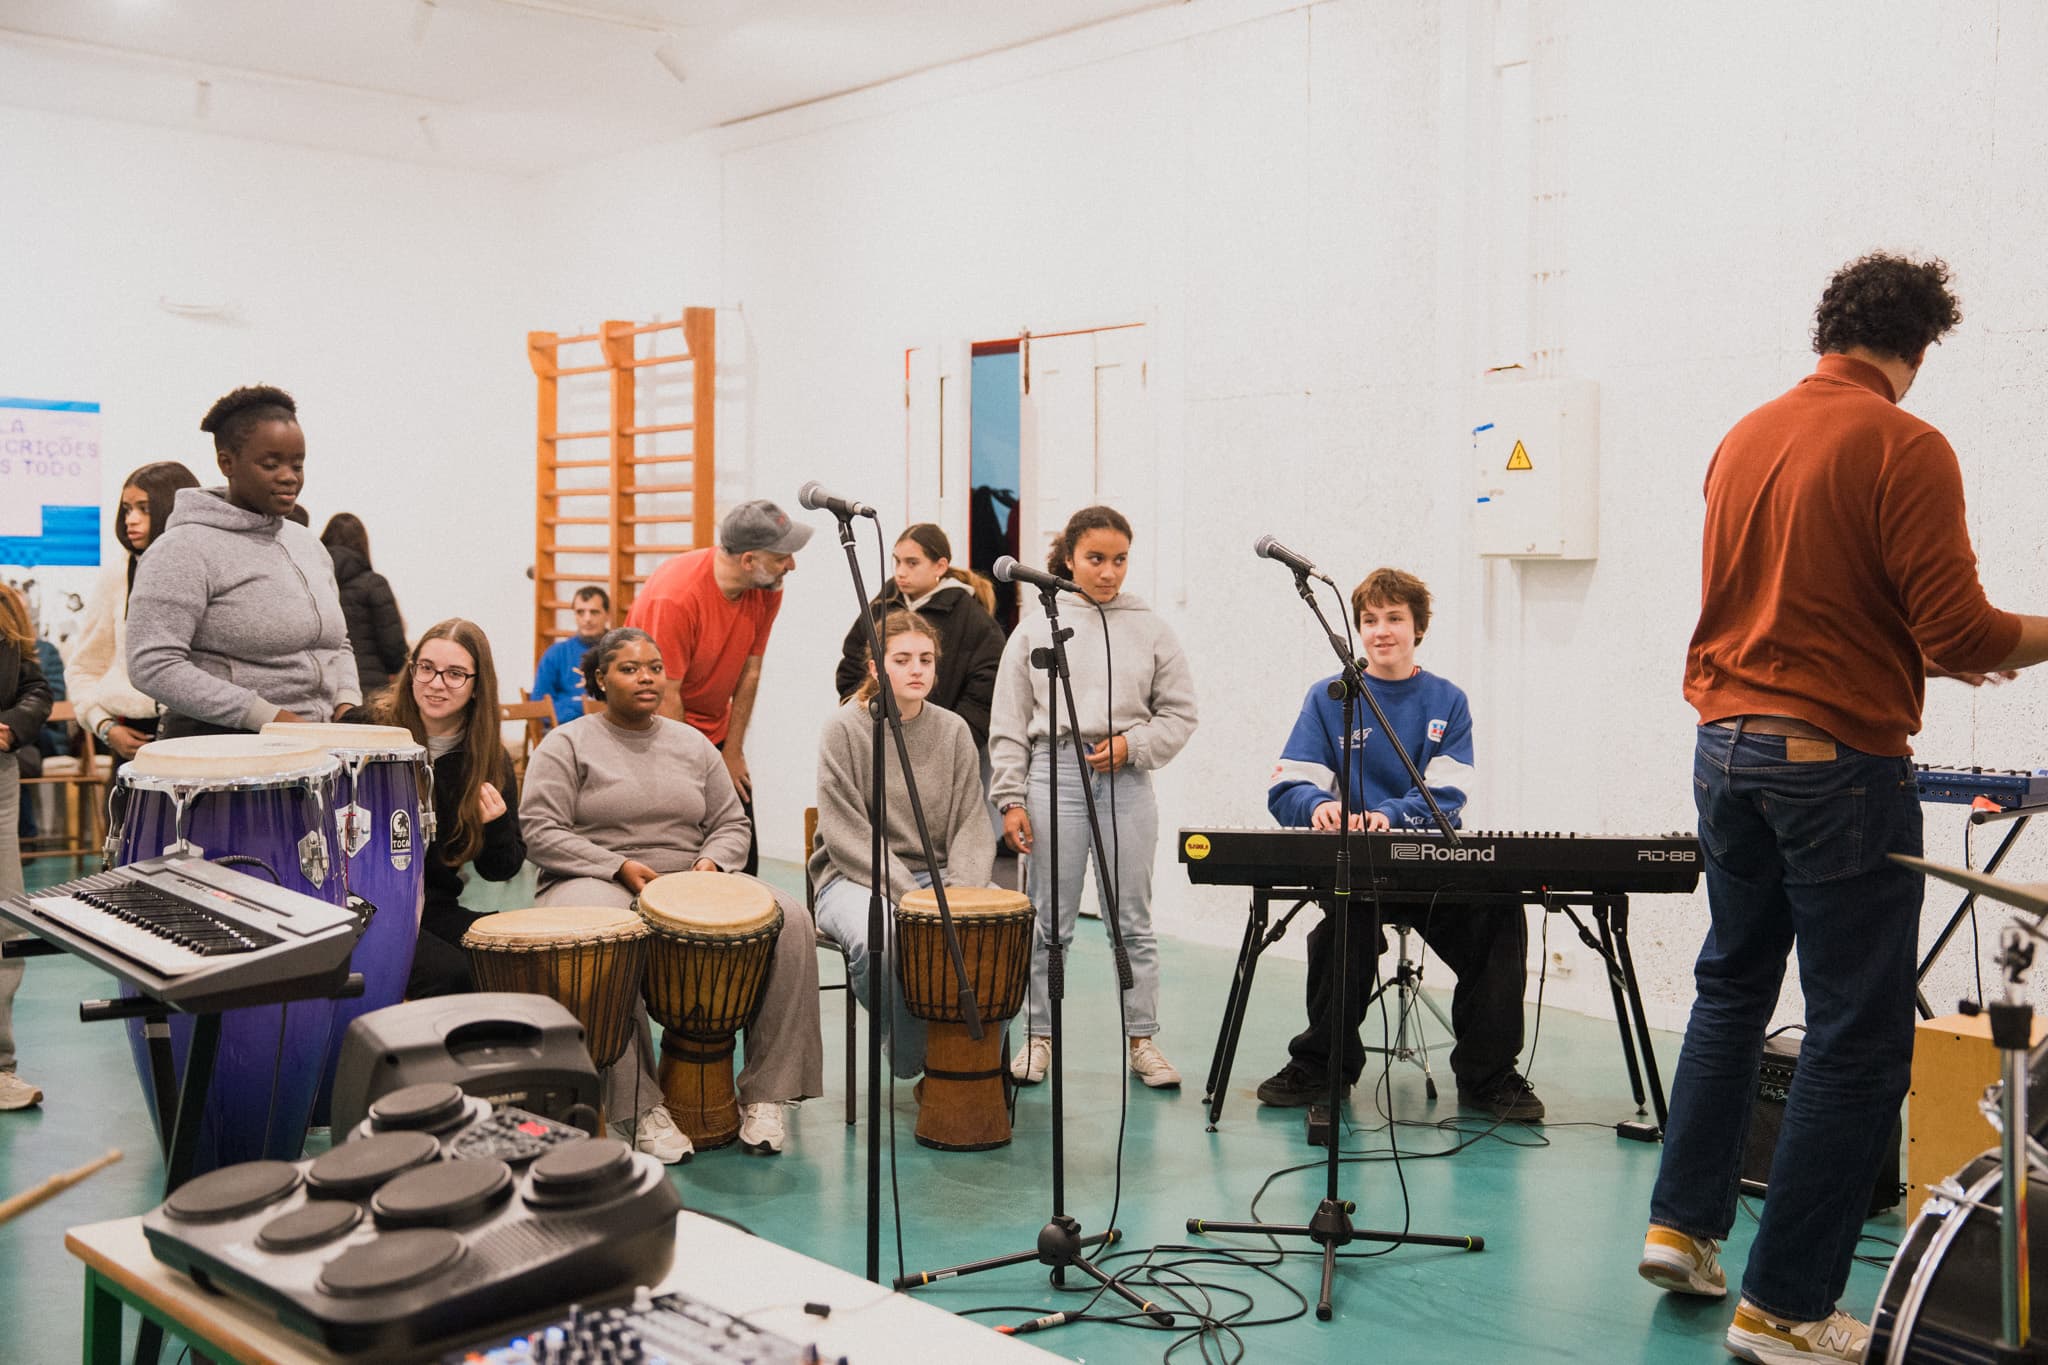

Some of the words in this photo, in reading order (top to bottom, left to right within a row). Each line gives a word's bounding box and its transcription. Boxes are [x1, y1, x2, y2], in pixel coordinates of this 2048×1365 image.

[0, 436, 98, 459] CRIÇÕES
[23, 459, 82, 477] TODO
[391, 839, 411, 849] TOCA
[1421, 844, 1495, 861] Roland
[1637, 850, 1697, 862] RD-88
[1818, 1324, 1852, 1352] N
